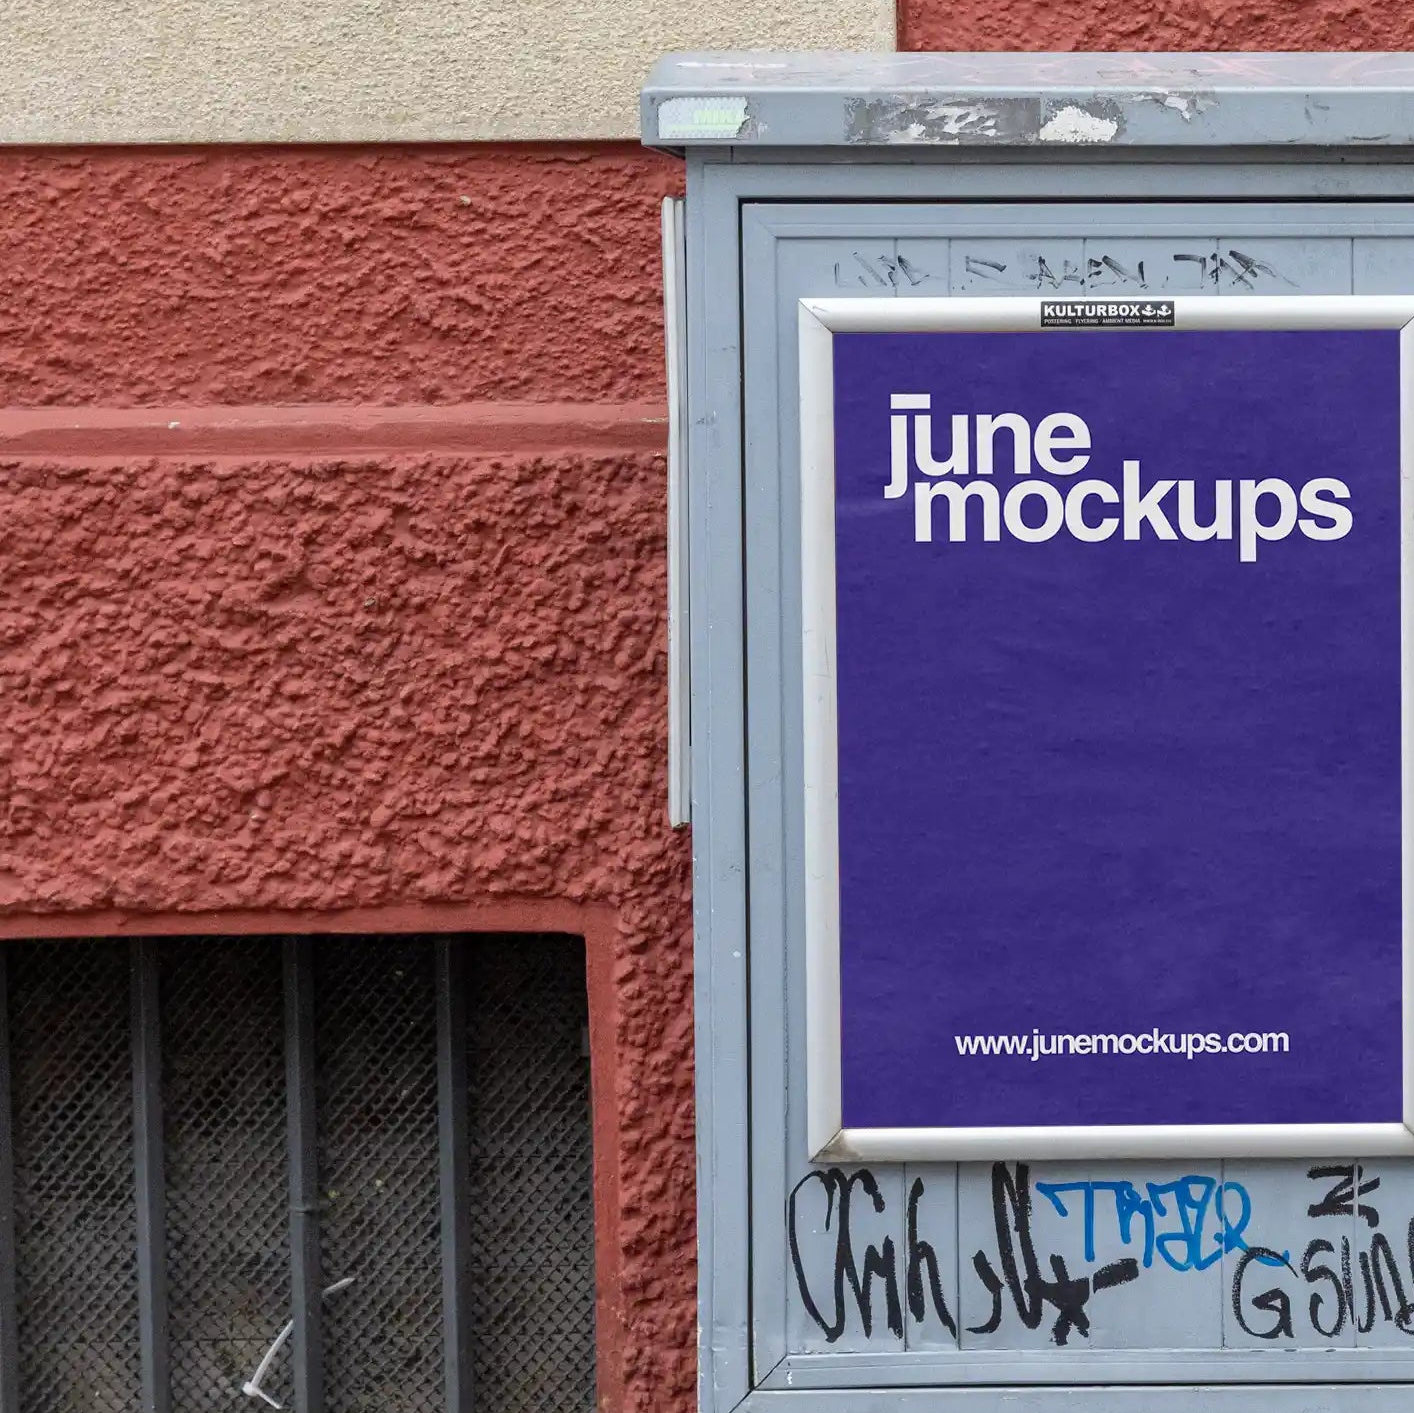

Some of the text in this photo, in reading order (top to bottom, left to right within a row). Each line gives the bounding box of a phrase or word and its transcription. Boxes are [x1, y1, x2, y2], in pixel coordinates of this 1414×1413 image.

[1044, 304, 1140, 317] KULTURBOX
[884, 393, 1091, 499] june
[914, 460, 1353, 562] mockups
[954, 1027, 1290, 1062] www.junemockups.com
